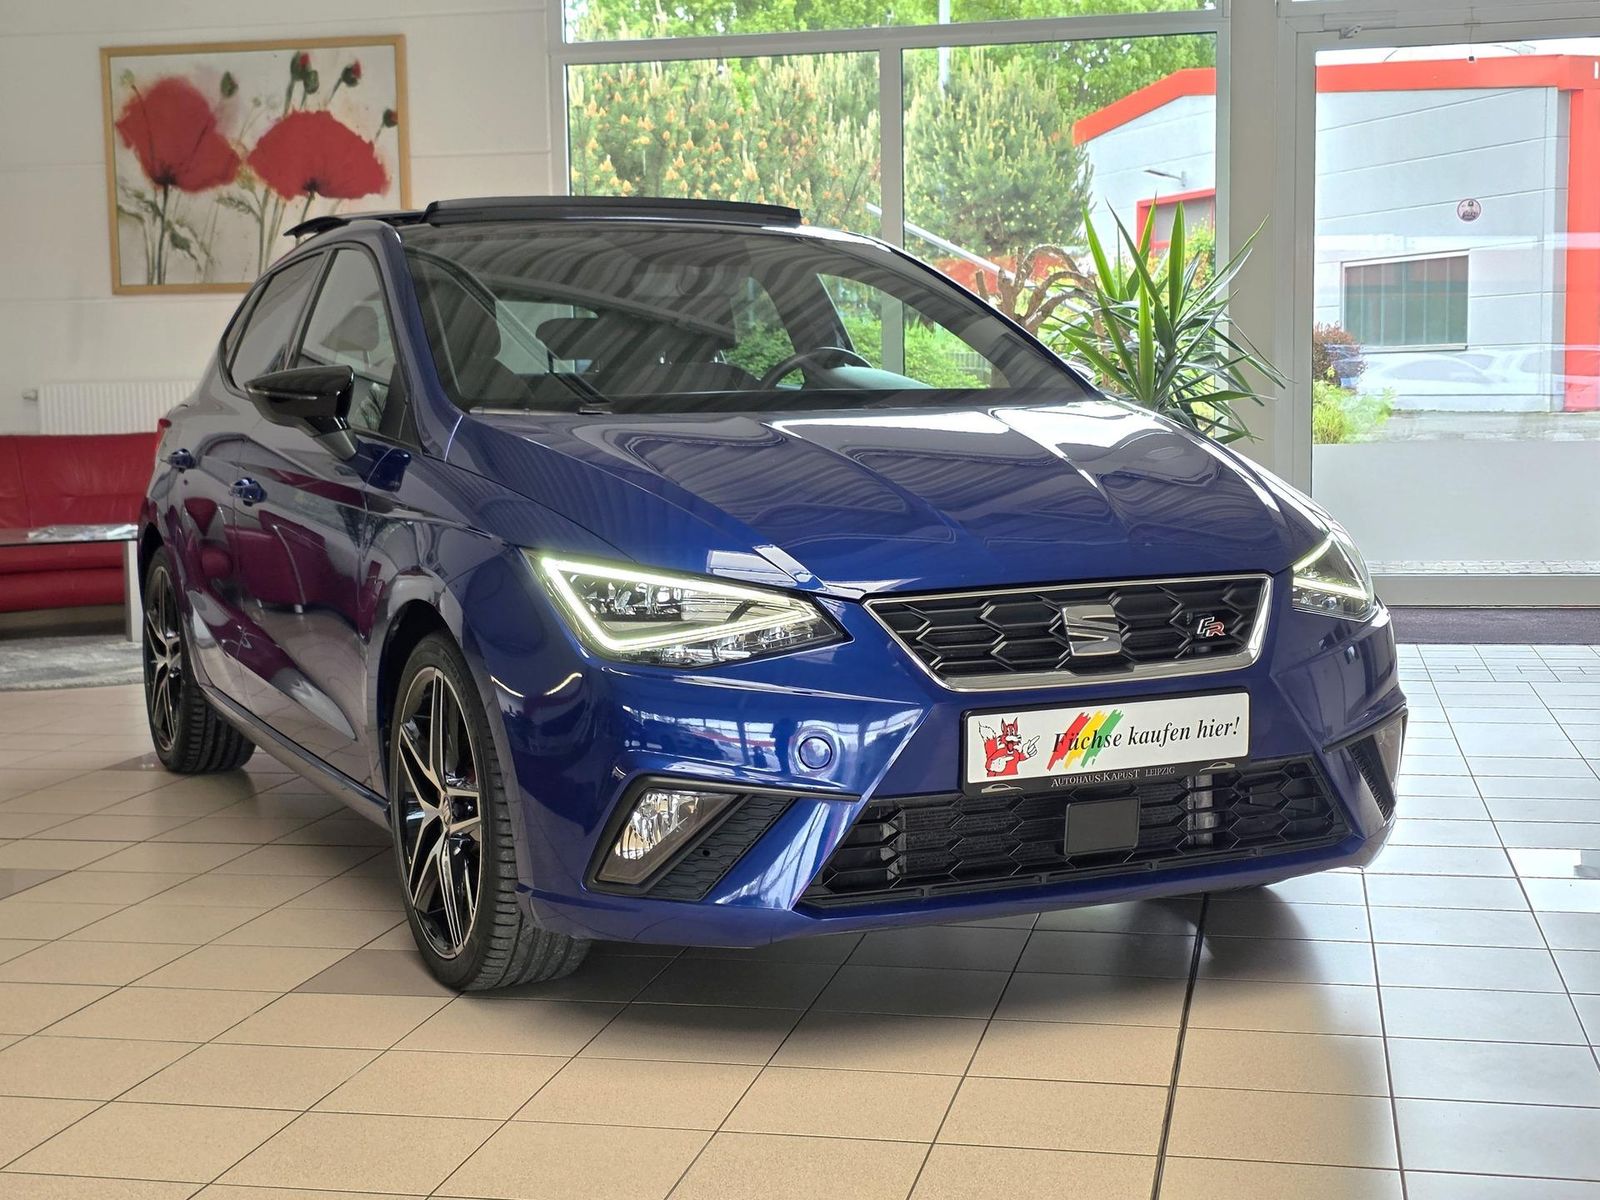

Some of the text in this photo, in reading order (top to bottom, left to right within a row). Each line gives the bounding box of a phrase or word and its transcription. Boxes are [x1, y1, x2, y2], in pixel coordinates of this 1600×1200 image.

[1197, 616, 1226, 638] FR
[1053, 716, 1240, 753] Füchse kaufen hier!
[1145, 767, 1175, 778] LEIPZIG
